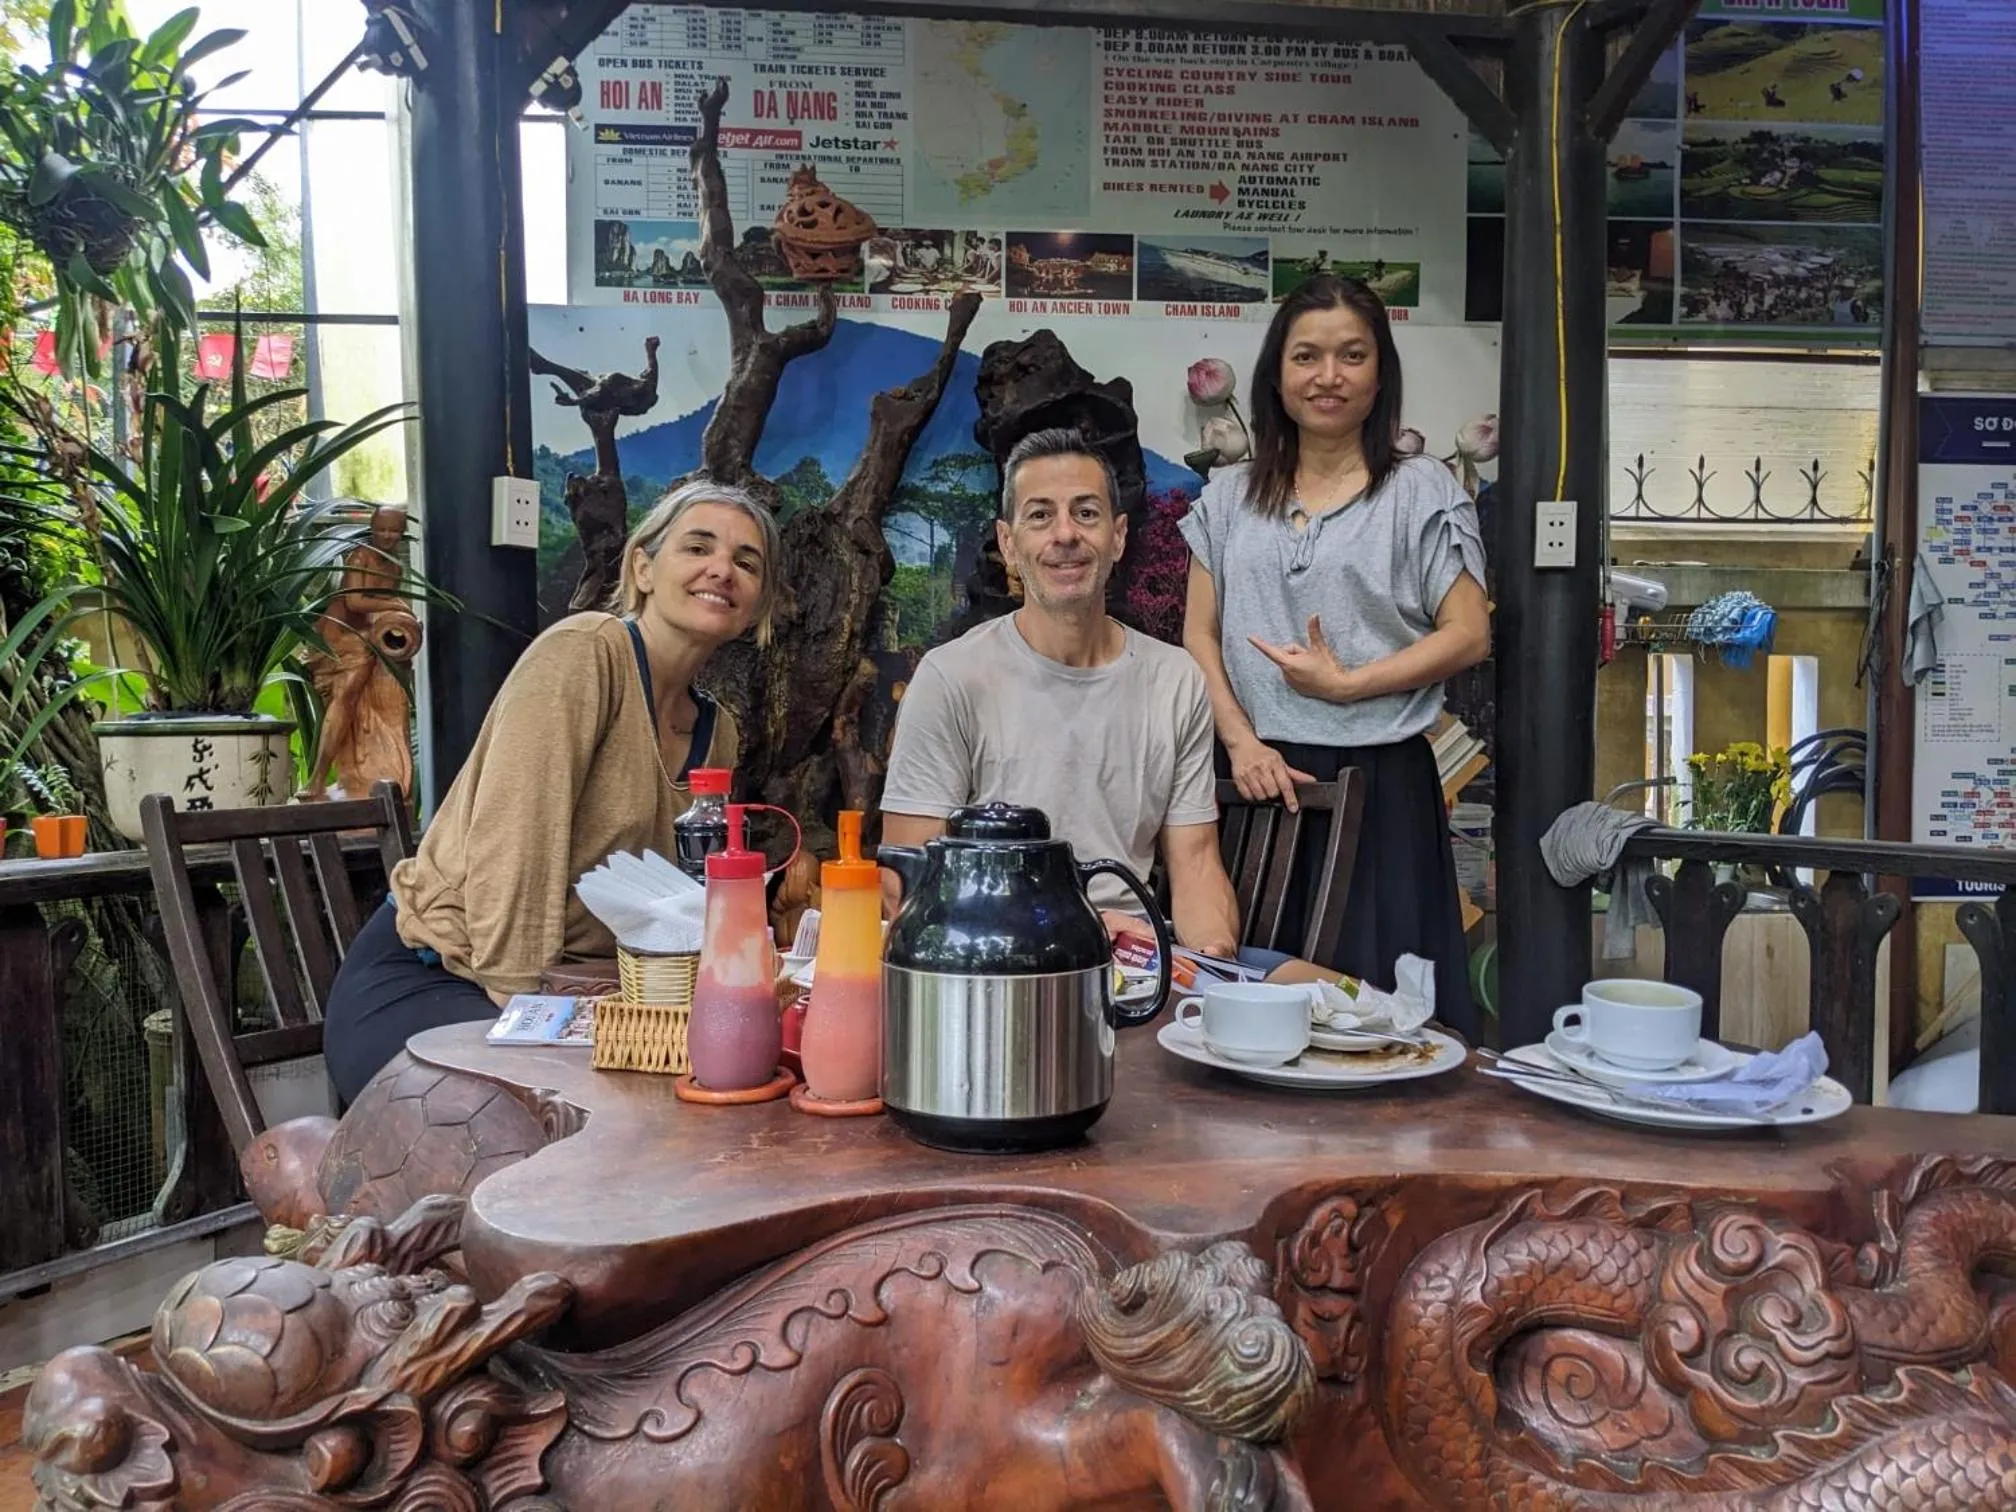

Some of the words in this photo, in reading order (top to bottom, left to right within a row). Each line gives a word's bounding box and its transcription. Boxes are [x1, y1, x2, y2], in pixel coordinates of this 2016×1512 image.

[1104, 40, 1130, 51] DEP
[1192, 43, 1246, 55] RETURN
[1286, 45, 1307, 57] PM
[1333, 47, 1359, 59] BUS
[597, 57, 628, 68] OPEN
[631, 59, 653, 69] BUS
[657, 60, 704, 70] TICKETS
[753, 63, 786, 74] TRAIN
[790, 64, 837, 75] TICKETS
[839, 66, 887, 77] SERVICE
[1103, 67, 1174, 79] CYCLING
[1179, 69, 1258, 81] COUNTRY
[1264, 71, 1302, 82] SIDE
[1310, 72, 1352, 84] TOUR
[769, 79, 813, 89] FROM
[1103, 81, 1177, 93] COOKING
[1183, 84, 1236, 95] CLASS
[600, 80, 631, 110] HOI
[638, 81, 663, 111] AN
[1103, 94, 1149, 105] EASY
[1156, 97, 1204, 108] RIDER
[753, 89, 779, 119] DA
[786, 89, 838, 121] NANG
[854, 111, 873, 119] NHA
[877, 112, 908, 120] TRANG
[1103, 108, 1273, 124] SNORKELING/DIVING
[1280, 113, 1301, 124] AT
[1307, 113, 1356, 126] CHAM
[1362, 115, 1420, 128] ISLAND
[854, 120, 871, 129] SAI
[1103, 122, 1173, 134] MARBLE
[808, 135, 881, 151] Jetstar
[1104, 134, 1137, 145] TAXI
[1146, 136, 1165, 146] OR
[1170, 137, 1231, 148] SHUTTLE
[1236, 139, 1263, 149] BUS
[621, 147, 668, 157] DOMESTIC
[1103, 146, 1143, 157] FROM
[1176, 148, 1195, 158] AN
[1202, 149, 1218, 160] TO
[1223, 150, 1242, 161] DA
[1246, 151, 1285, 161] NANG
[1290, 152, 1348, 163] AIRPORT
[763, 163, 791, 171] FROM
[1103, 158, 1146, 169] TRAIN
[1150, 159, 1236, 172] STATION/DA
[1241, 163, 1279, 173] NANG
[1284, 163, 1315, 173] CITY
[1237, 174, 1321, 186] AUTOMATIC
[1102, 182, 1145, 192] BIKES
[1150, 183, 1205, 194] RENTED
[1237, 186, 1296, 198] MANUAL
[1173, 209, 1233, 219] LAUNDRY
[1235, 211, 1255, 220] AS
[1256, 212, 1293, 222] WELL
[622, 290, 639, 303] HA
[643, 291, 674, 304] LONG
[676, 291, 700, 305] BAY
[776, 293, 809, 307] CHAM
[891, 297, 941, 311] COOKING
[1008, 301, 1028, 313] HOI
[1031, 302, 1047, 314] AN
[1051, 302, 1094, 315] ANCIEN
[1164, 303, 1198, 317] CHAM
[1200, 305, 1241, 318] ISLAND
[1973, 416, 1999, 431] SƠ
[2001, 416, 2016, 431] Đ
